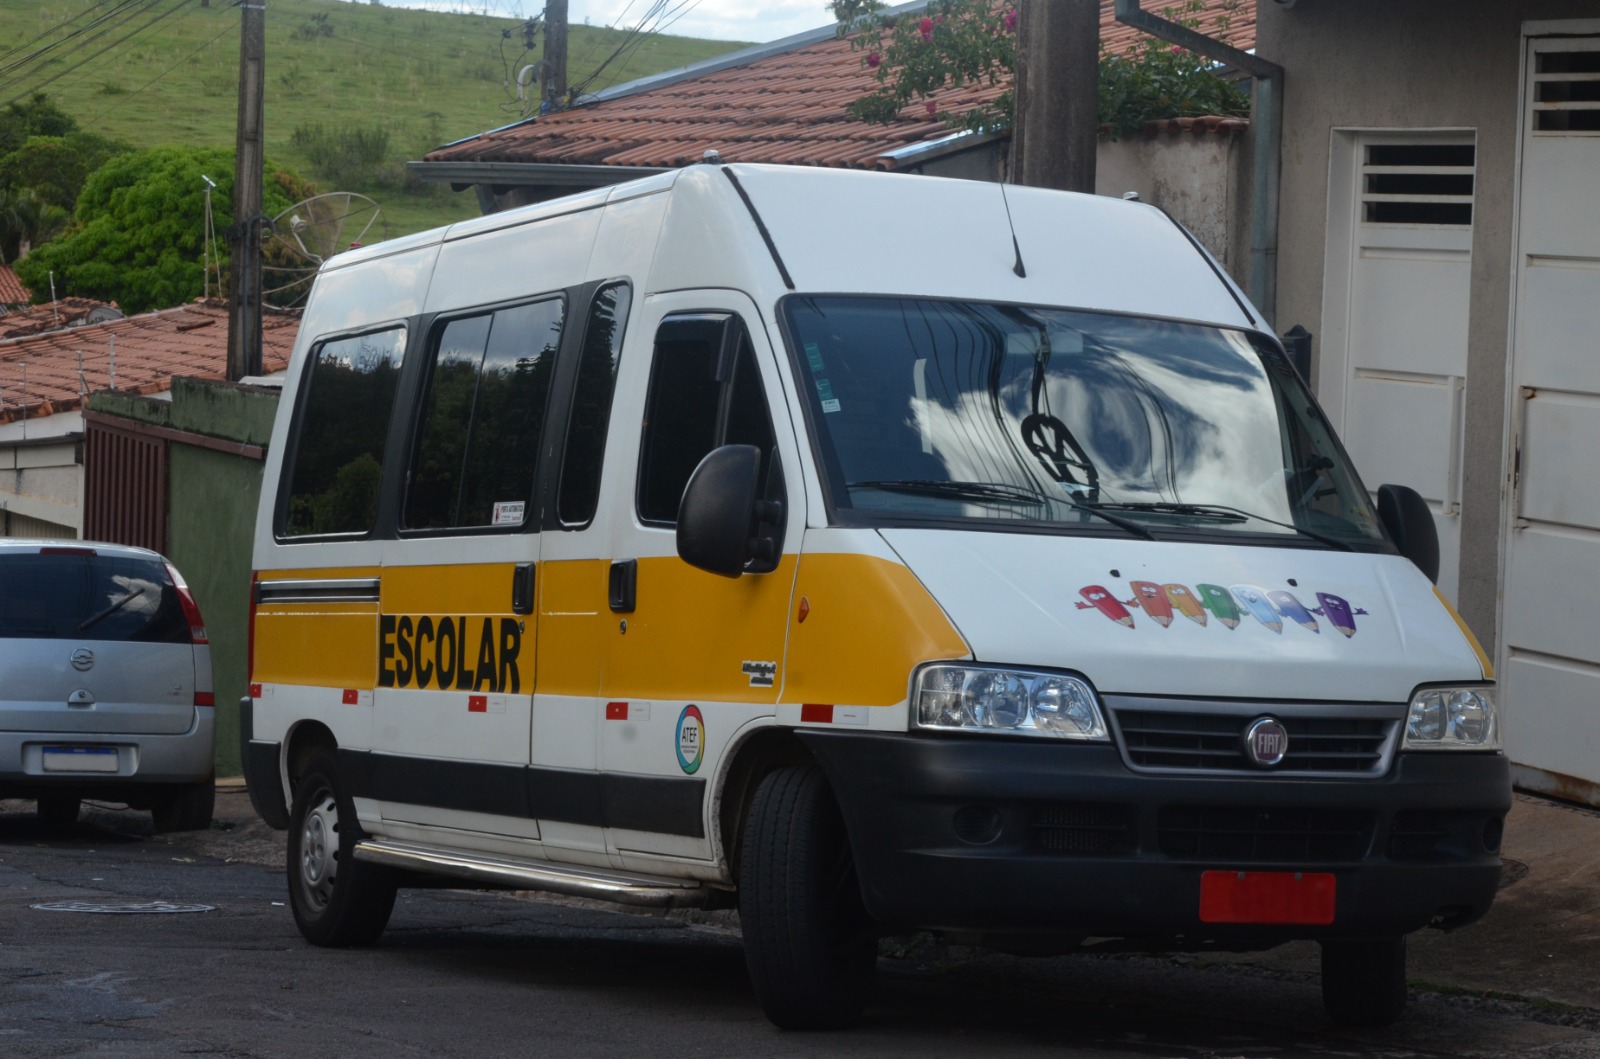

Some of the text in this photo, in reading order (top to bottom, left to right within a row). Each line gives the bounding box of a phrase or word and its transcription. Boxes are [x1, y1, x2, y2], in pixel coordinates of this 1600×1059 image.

[378, 615, 521, 694] ESCOLAR
[681, 727, 697, 743] ATEF
[1258, 733, 1281, 754] FIAT
